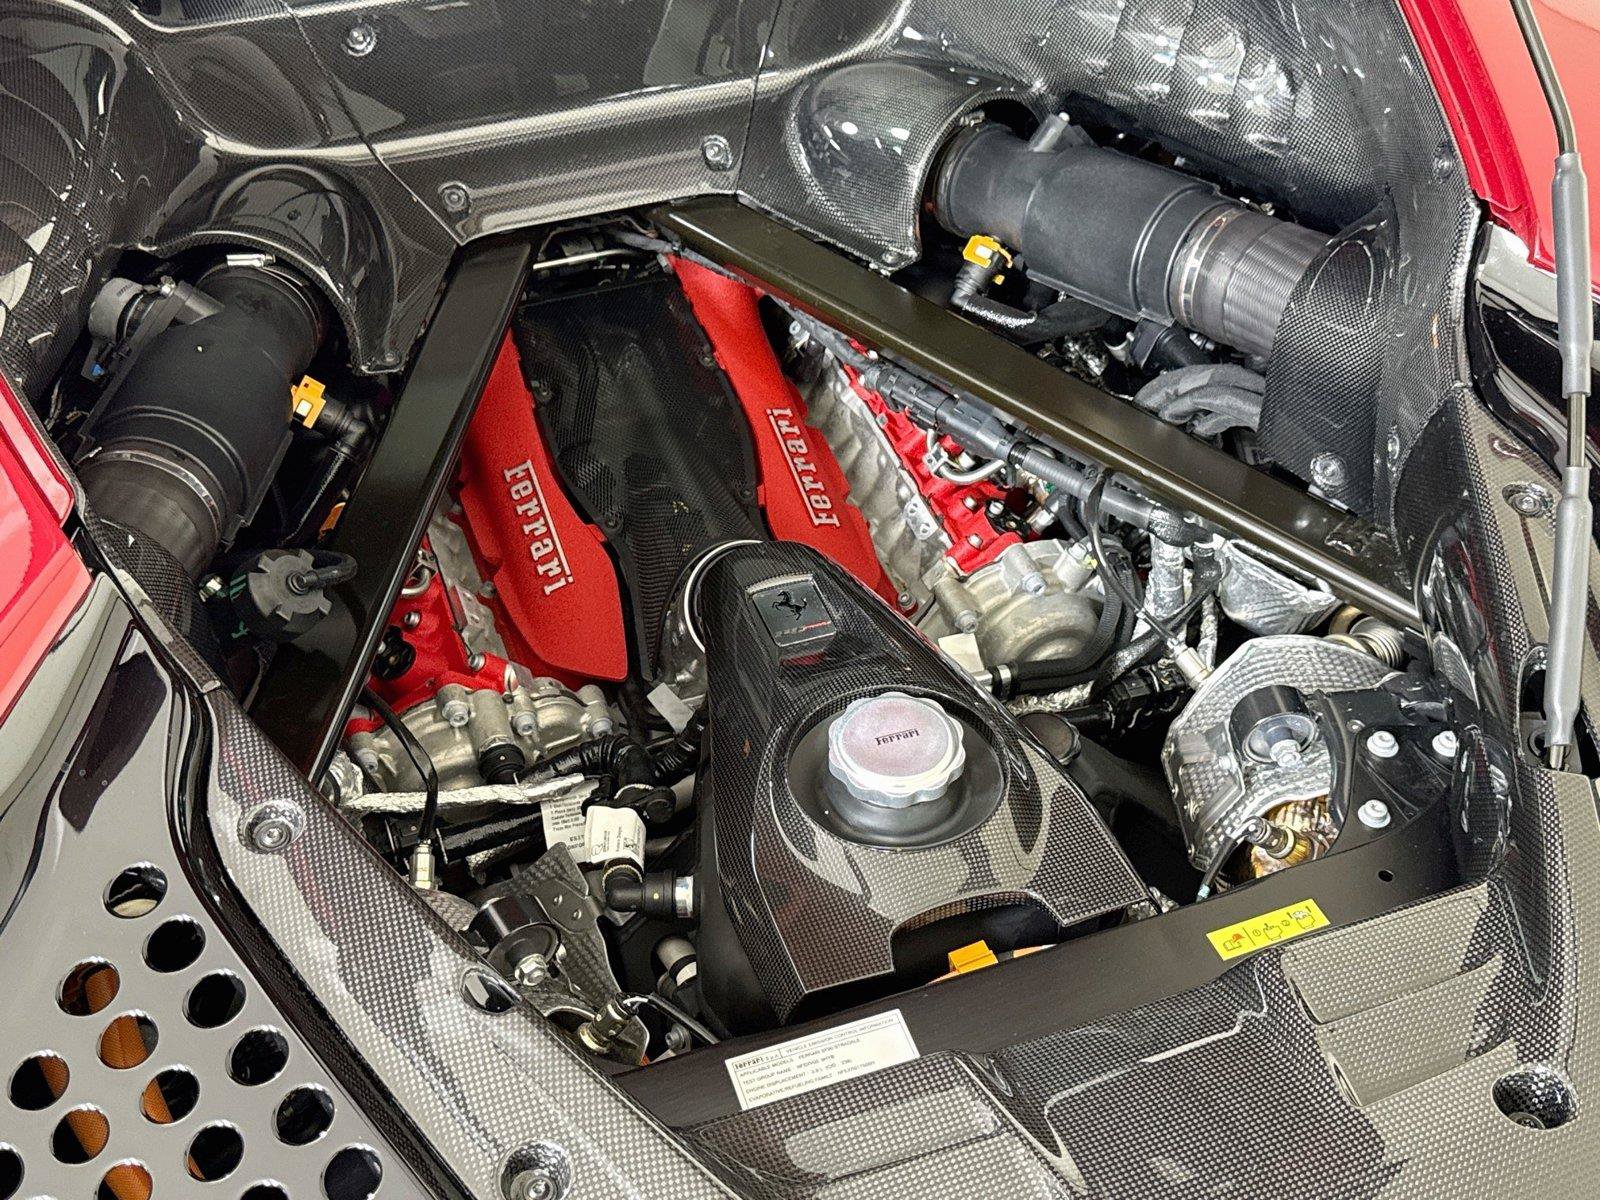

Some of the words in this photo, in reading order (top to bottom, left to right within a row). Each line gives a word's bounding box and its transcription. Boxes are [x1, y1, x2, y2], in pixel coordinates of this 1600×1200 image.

[767, 408, 840, 527] Ferrari
[503, 459, 574, 596] Ferrari
[874, 729, 920, 745] Ferrari
